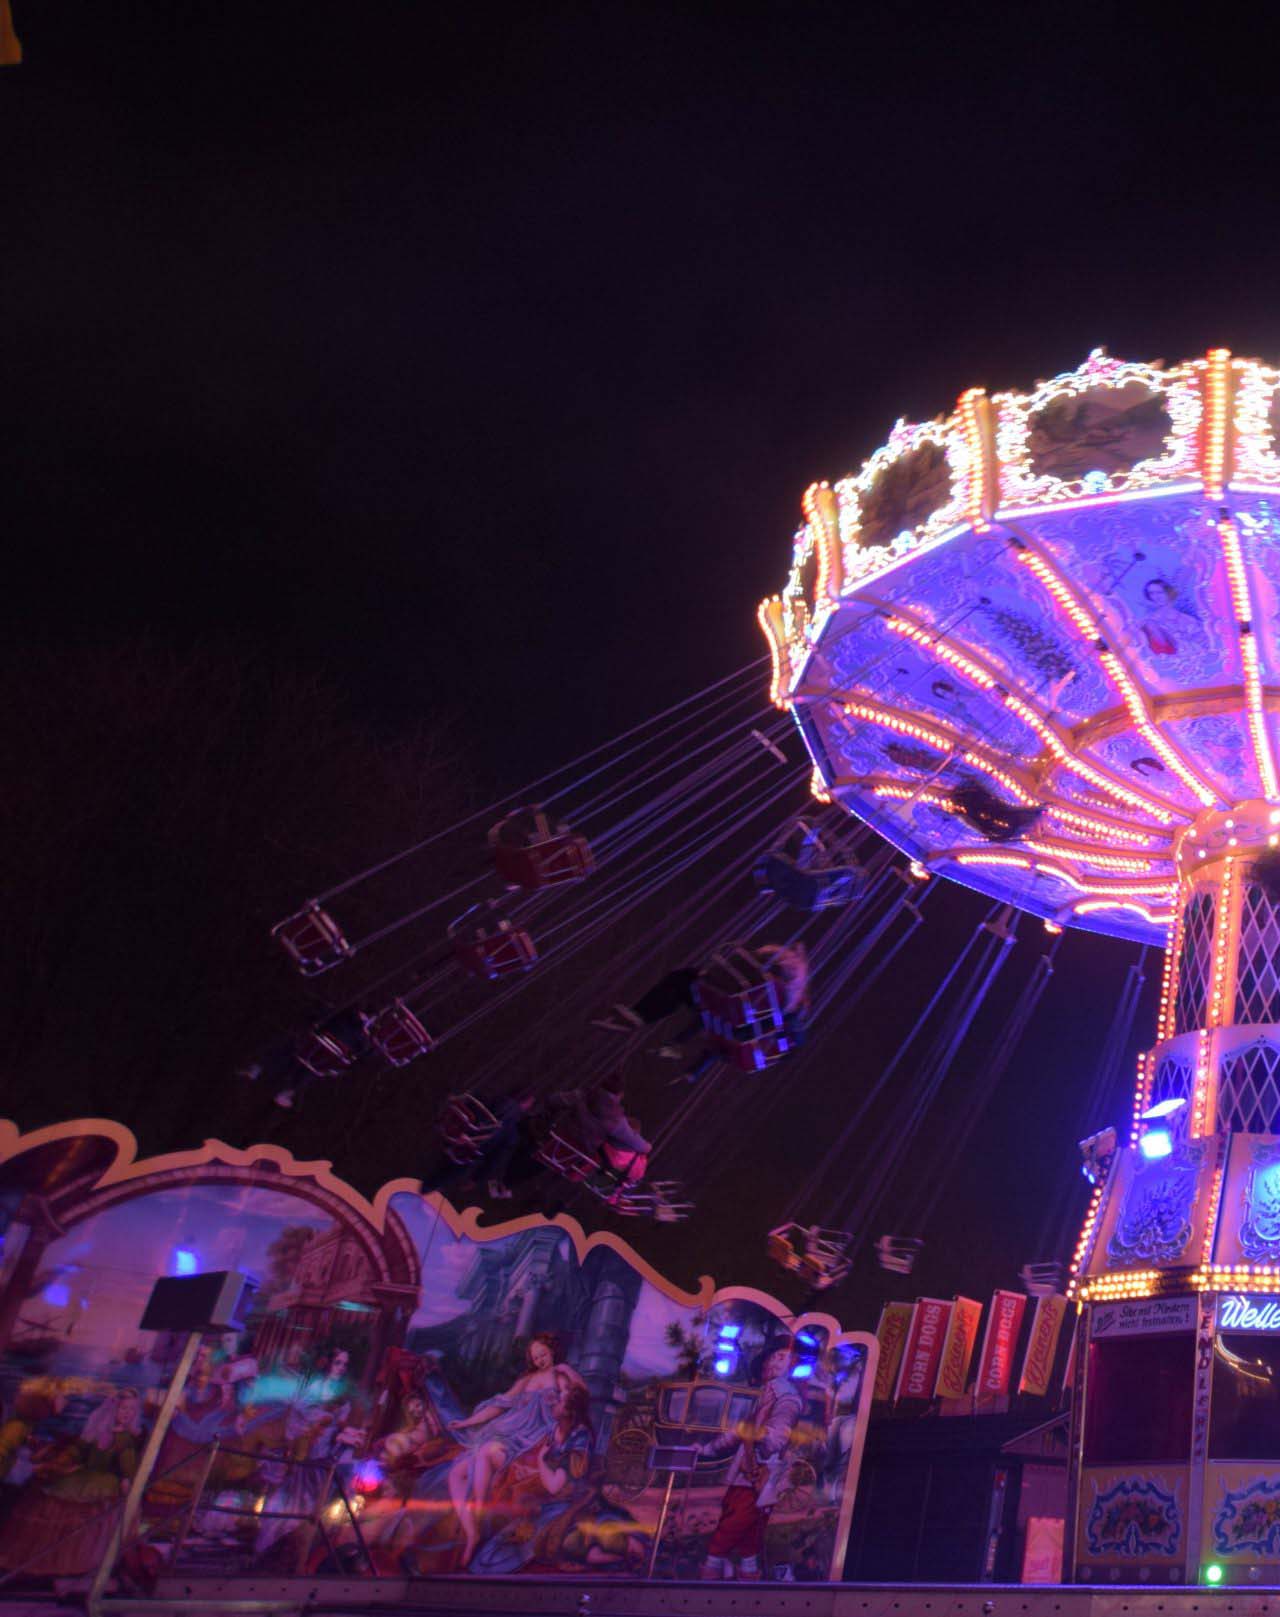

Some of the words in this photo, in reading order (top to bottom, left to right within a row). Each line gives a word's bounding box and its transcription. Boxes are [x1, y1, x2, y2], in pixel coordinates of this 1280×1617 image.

[917, 1304, 942, 1347] DOGS
[985, 1344, 1008, 1390] CORN
[998, 1298, 1017, 1342] DOGS
[907, 1348, 930, 1394] CORN
